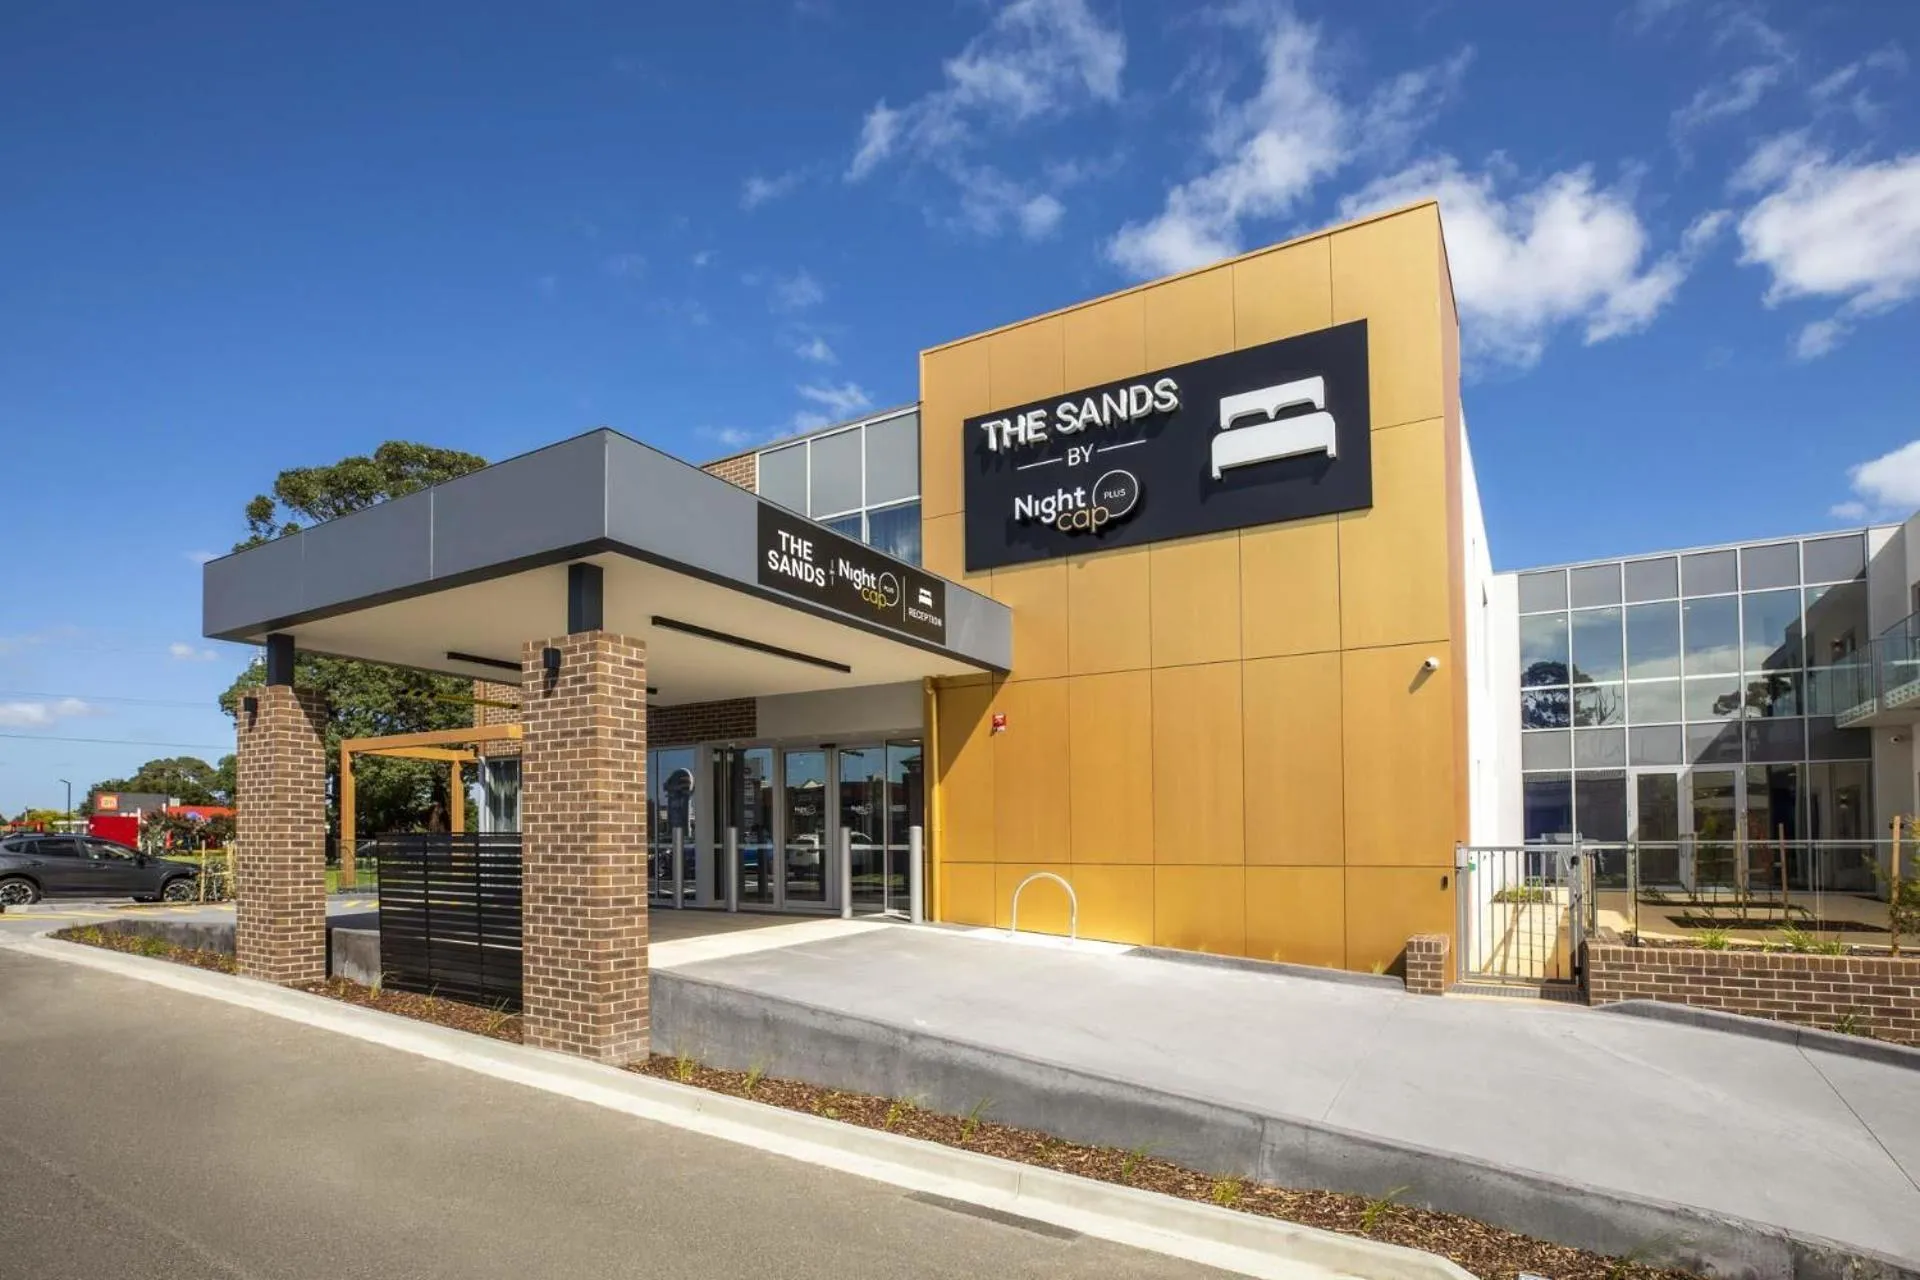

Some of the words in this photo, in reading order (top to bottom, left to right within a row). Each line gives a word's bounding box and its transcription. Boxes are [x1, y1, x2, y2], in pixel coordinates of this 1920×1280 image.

[981, 409, 1047, 451] THE
[1055, 378, 1178, 434] SANDS
[1068, 443, 1094, 466] BY
[1014, 487, 1086, 523] Night
[1103, 488, 1126, 500] PLUS
[1057, 506, 1109, 533] cap
[778, 529, 813, 562] THE
[768, 550, 825, 587] SANDS
[839, 558, 876, 590] Night
[862, 588, 886, 610] cap
[908, 607, 942, 627] RECEPTION
